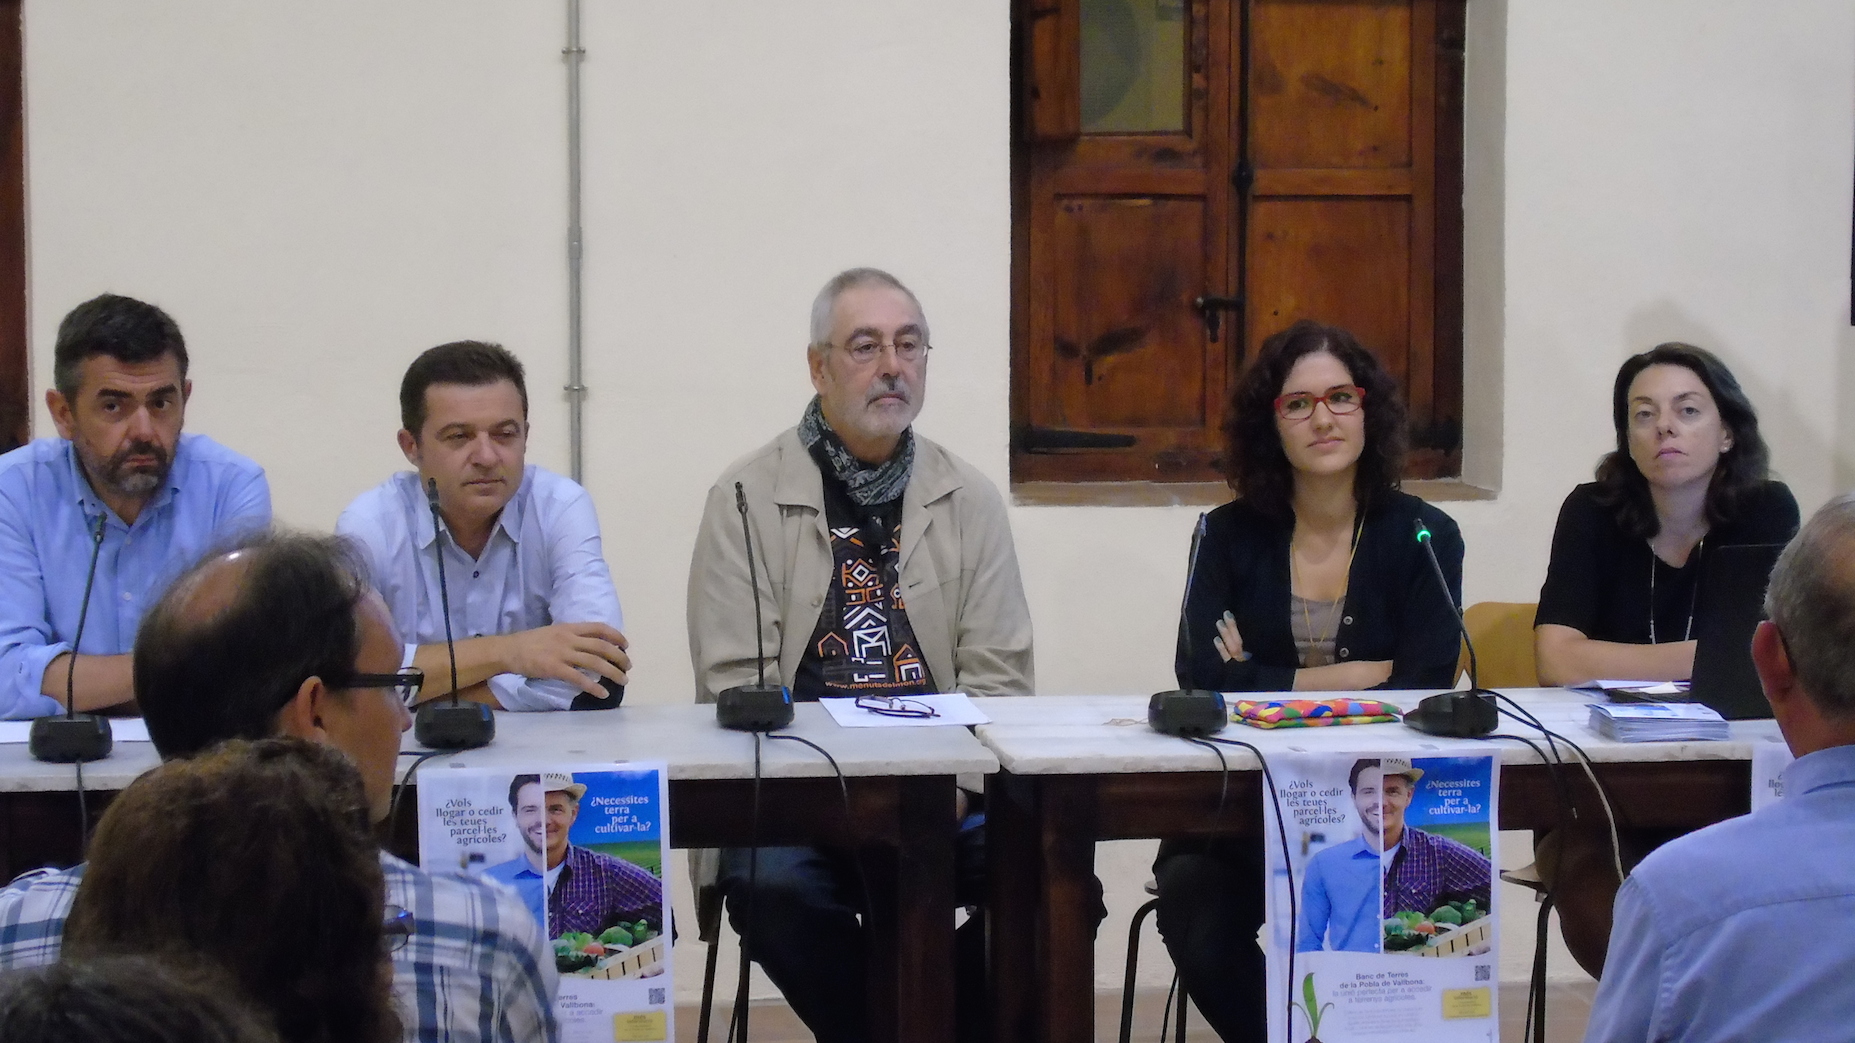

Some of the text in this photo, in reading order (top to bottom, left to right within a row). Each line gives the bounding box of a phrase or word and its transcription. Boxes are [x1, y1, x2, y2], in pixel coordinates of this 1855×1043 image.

[1289, 779, 1313, 789] ¿Vols
[1426, 779, 1480, 789] ¿Necessites
[1280, 789, 1307, 800] llogar
[1319, 788, 1343, 797] cedir
[446, 798, 472, 808] ¿Vols
[591, 795, 649, 807] ¿Necessites
[1286, 798, 1299, 807] les
[1444, 798, 1460, 807] per
[436, 808, 465, 819] llogar
[478, 806, 504, 816] cedir
[605, 806, 630, 815] terra
[1429, 804, 1482, 815] cultivar-la?
[443, 818, 457, 826] les
[611, 815, 637, 825] per a
[595, 821, 651, 833] cultivar-la?
